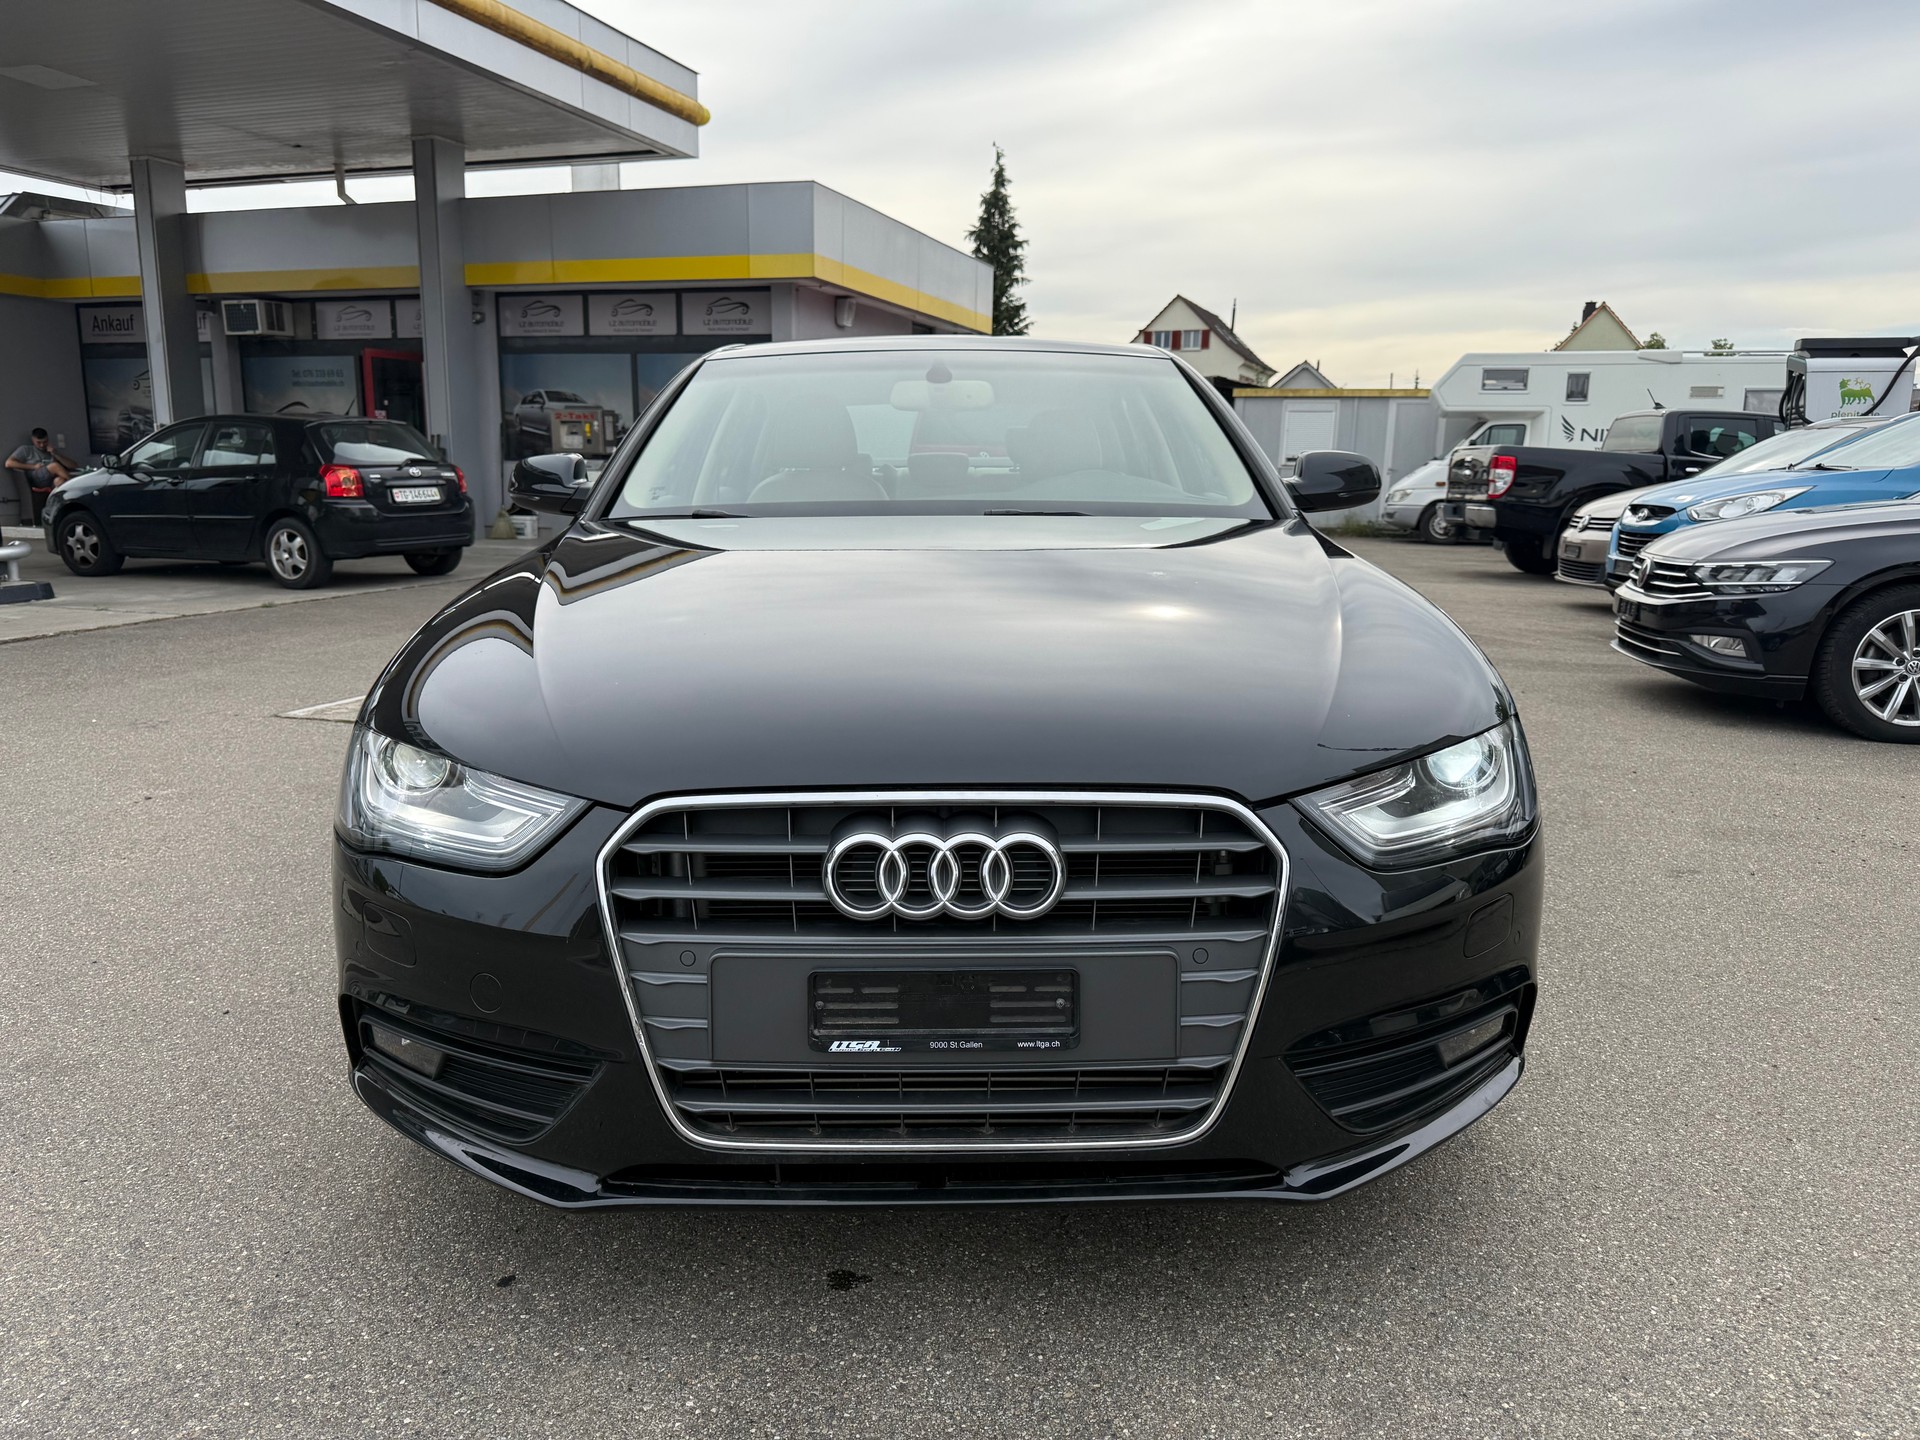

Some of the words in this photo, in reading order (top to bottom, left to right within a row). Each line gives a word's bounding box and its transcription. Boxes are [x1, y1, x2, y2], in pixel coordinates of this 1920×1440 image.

[91, 313, 135, 332] Ankauf
[1830, 410, 1881, 419] plenitde
[1580, 428, 1610, 442] NI
[929, 1041, 948, 1049] 9000
[1016, 1040, 1061, 1050] www.ltga.ch
